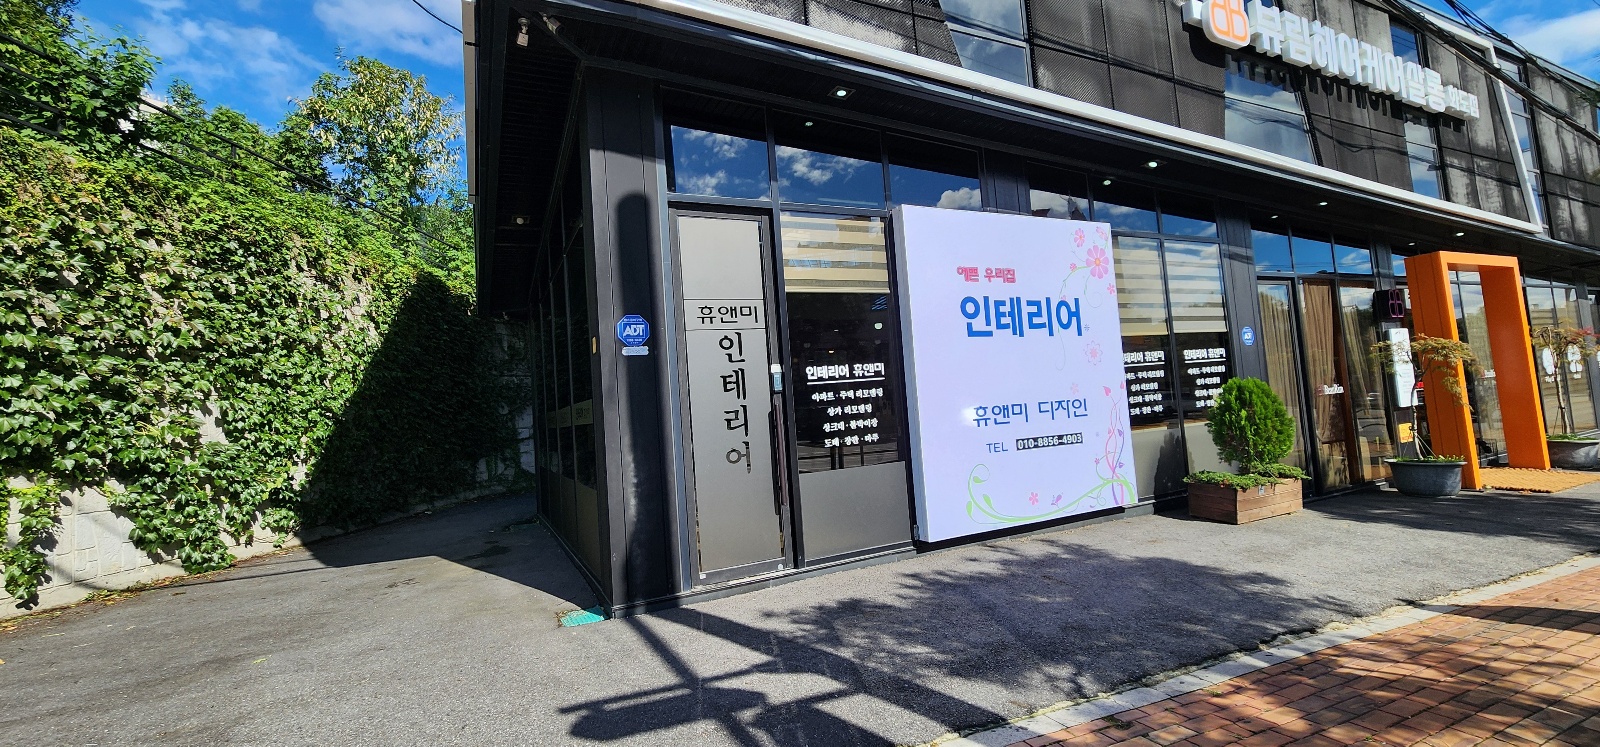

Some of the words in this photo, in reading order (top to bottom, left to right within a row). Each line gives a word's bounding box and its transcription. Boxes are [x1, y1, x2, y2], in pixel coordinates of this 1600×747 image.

[957, 266, 979, 282] 예쁜
[984, 267, 1016, 283] 우리집
[697, 305, 758, 324] 휴앤미
[960, 296, 1082, 337] 인테리어
[622, 324, 645, 337] ADT
[1122, 351, 1144, 364] 테리어
[805, 364, 850, 380] 인테리어
[853, 362, 885, 377] 휴앤미
[855, 387, 884, 399] 리모델링
[718, 331, 752, 474] 인테리어
[826, 406, 843, 417] 상가
[843, 403, 873, 415] 리모델링
[973, 403, 1029, 427] 휴앤미
[1038, 398, 1088, 420] 디자인
[986, 442, 1009, 453] TEL
[1016, 432, 1083, 451] 010-8856-4903
